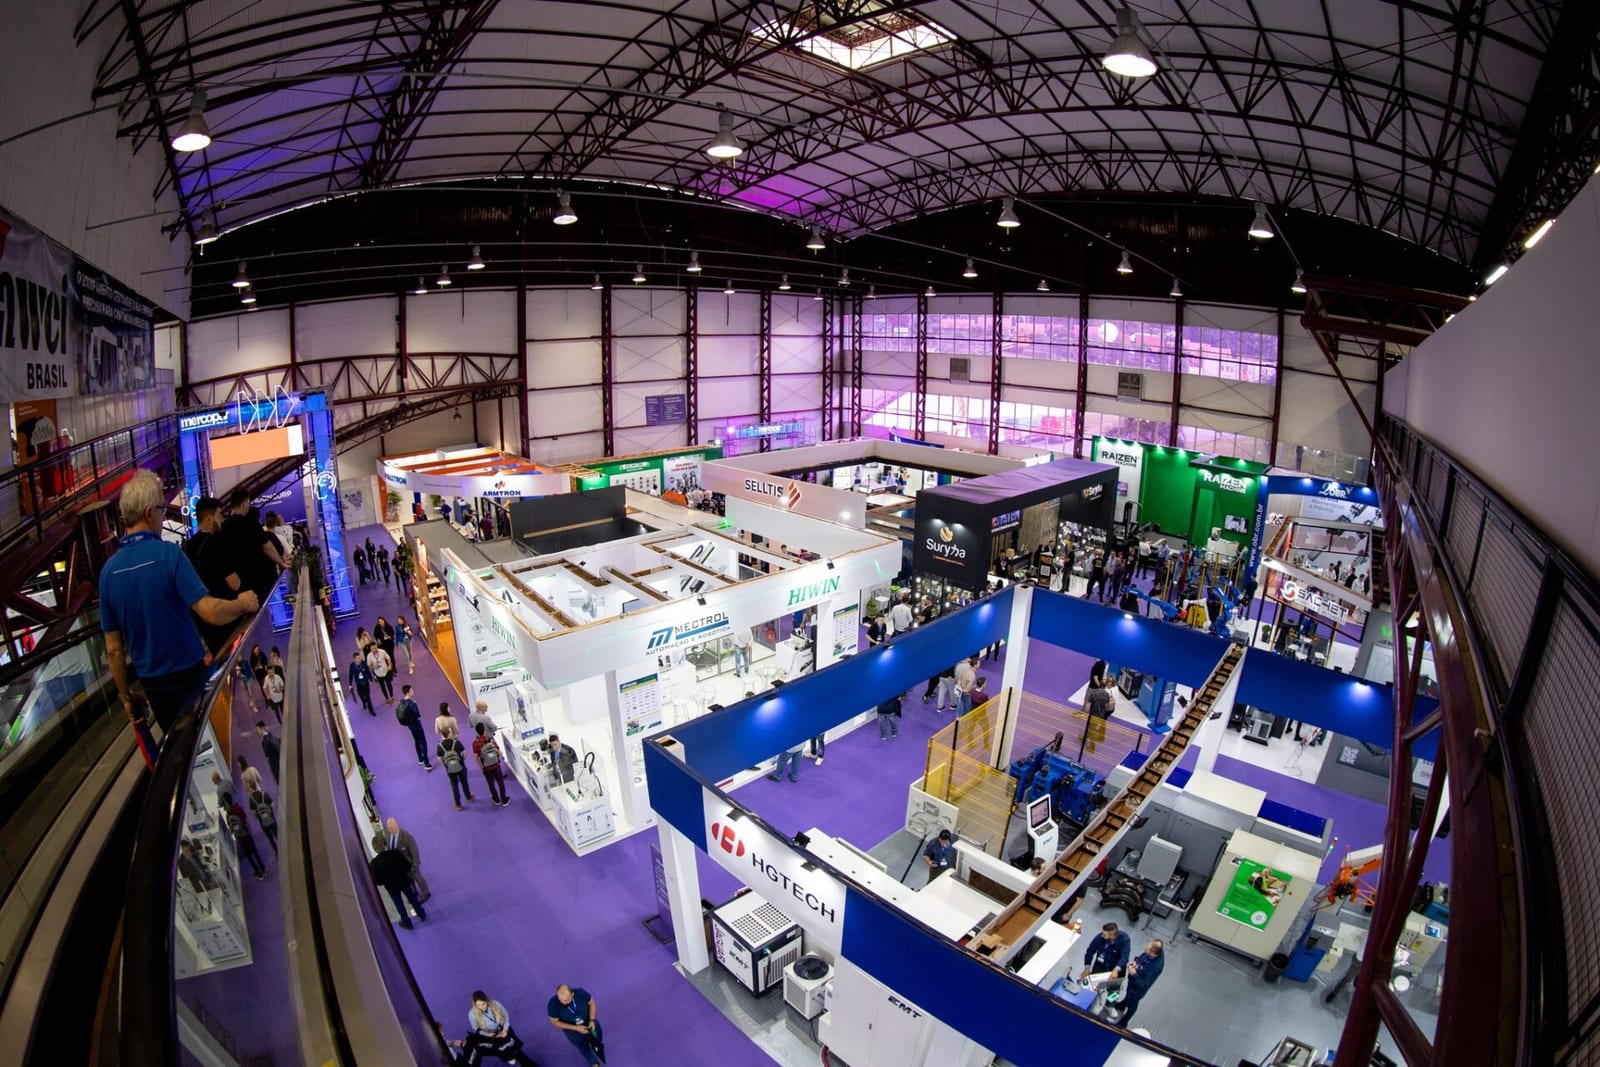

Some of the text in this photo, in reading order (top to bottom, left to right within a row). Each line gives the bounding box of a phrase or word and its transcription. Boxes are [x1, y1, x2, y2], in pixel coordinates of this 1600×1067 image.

[27, 362, 68, 390] BRASIL
[1102, 450, 1137, 463] RAIZEN
[1115, 460, 1137, 468] MACHINE
[744, 479, 784, 498] SELLTIS
[1203, 471, 1248, 490] RAIZEN
[1249, 503, 1264, 567] www.obr.com.br
[926, 538, 966, 559] Suryha
[787, 576, 841, 606] HIWIN
[492, 616, 516, 649] HIWIN
[674, 611, 729, 634] MECTROL
[751, 852, 836, 923] HGTECH
